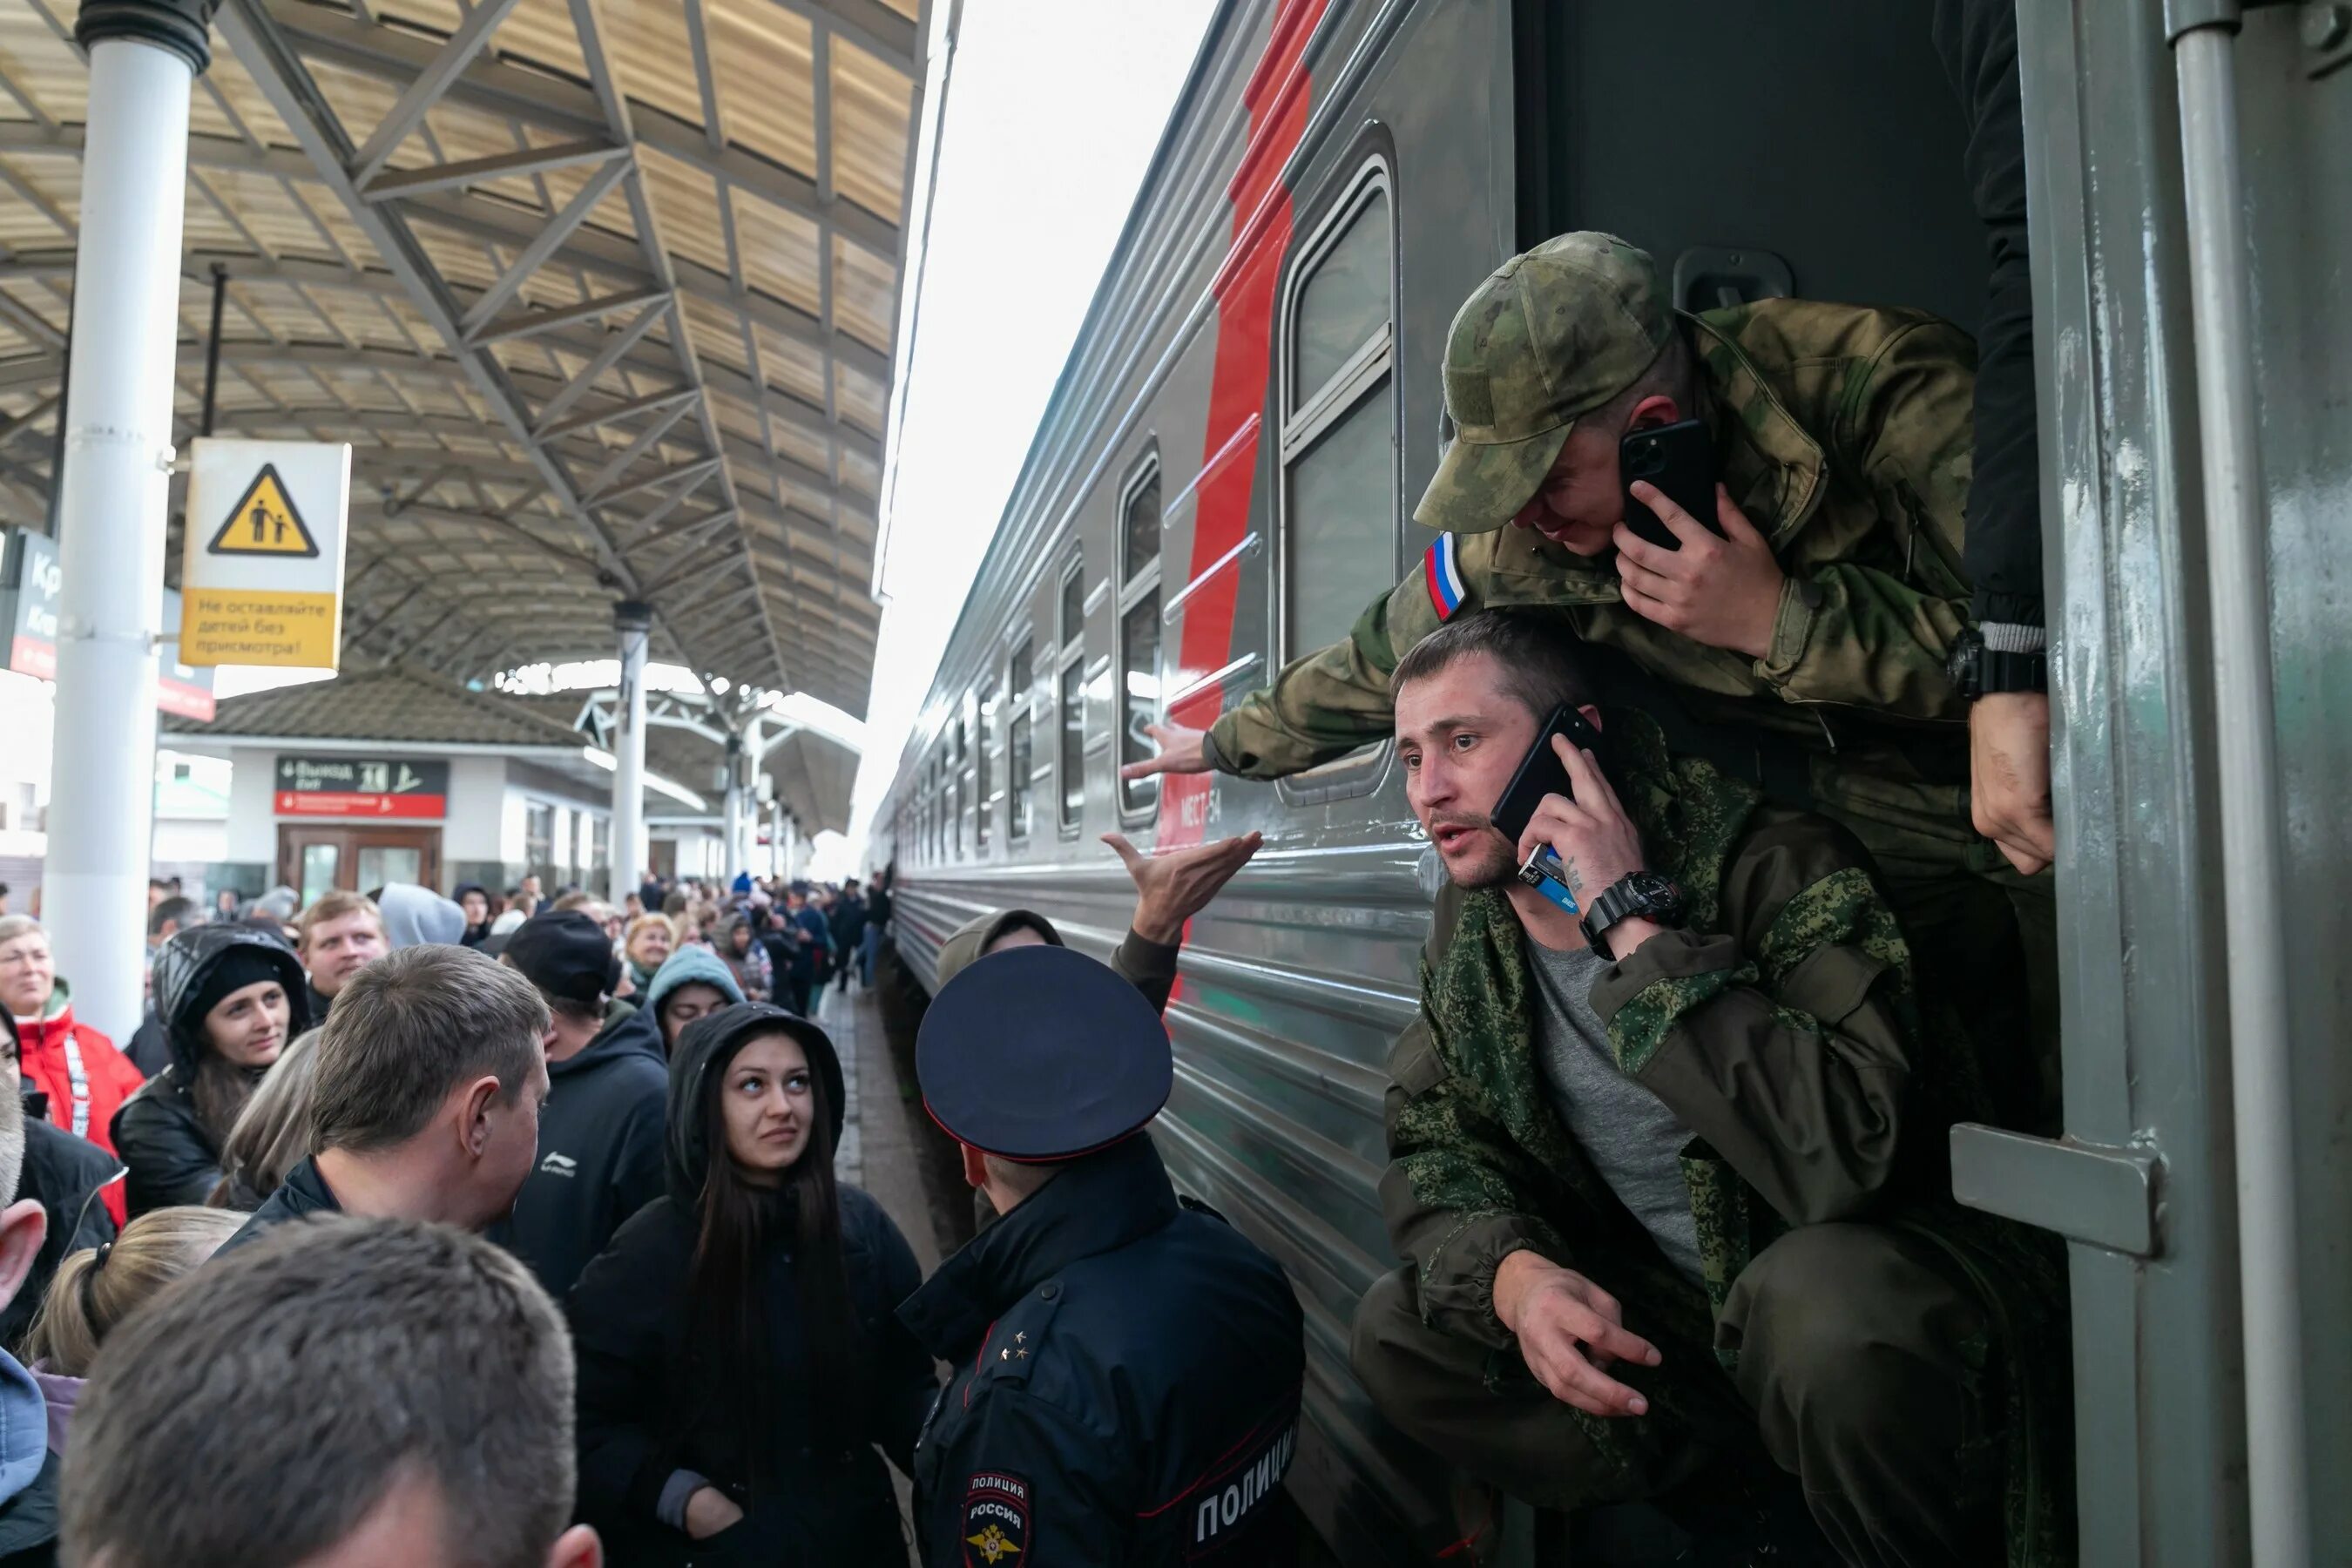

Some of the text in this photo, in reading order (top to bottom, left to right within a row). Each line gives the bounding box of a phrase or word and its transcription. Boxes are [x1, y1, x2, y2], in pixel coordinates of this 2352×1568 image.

[199, 599, 326, 617] Не оставляйте
[198, 619, 286, 634] детей без
[196, 639, 302, 656] присмотра!
[972, 1477, 1024, 1499] ПОЛИЦИЯ
[1197, 1424, 1296, 1543] ПОЛИЦИ
[970, 1503, 1022, 1530] РОССИЯ
